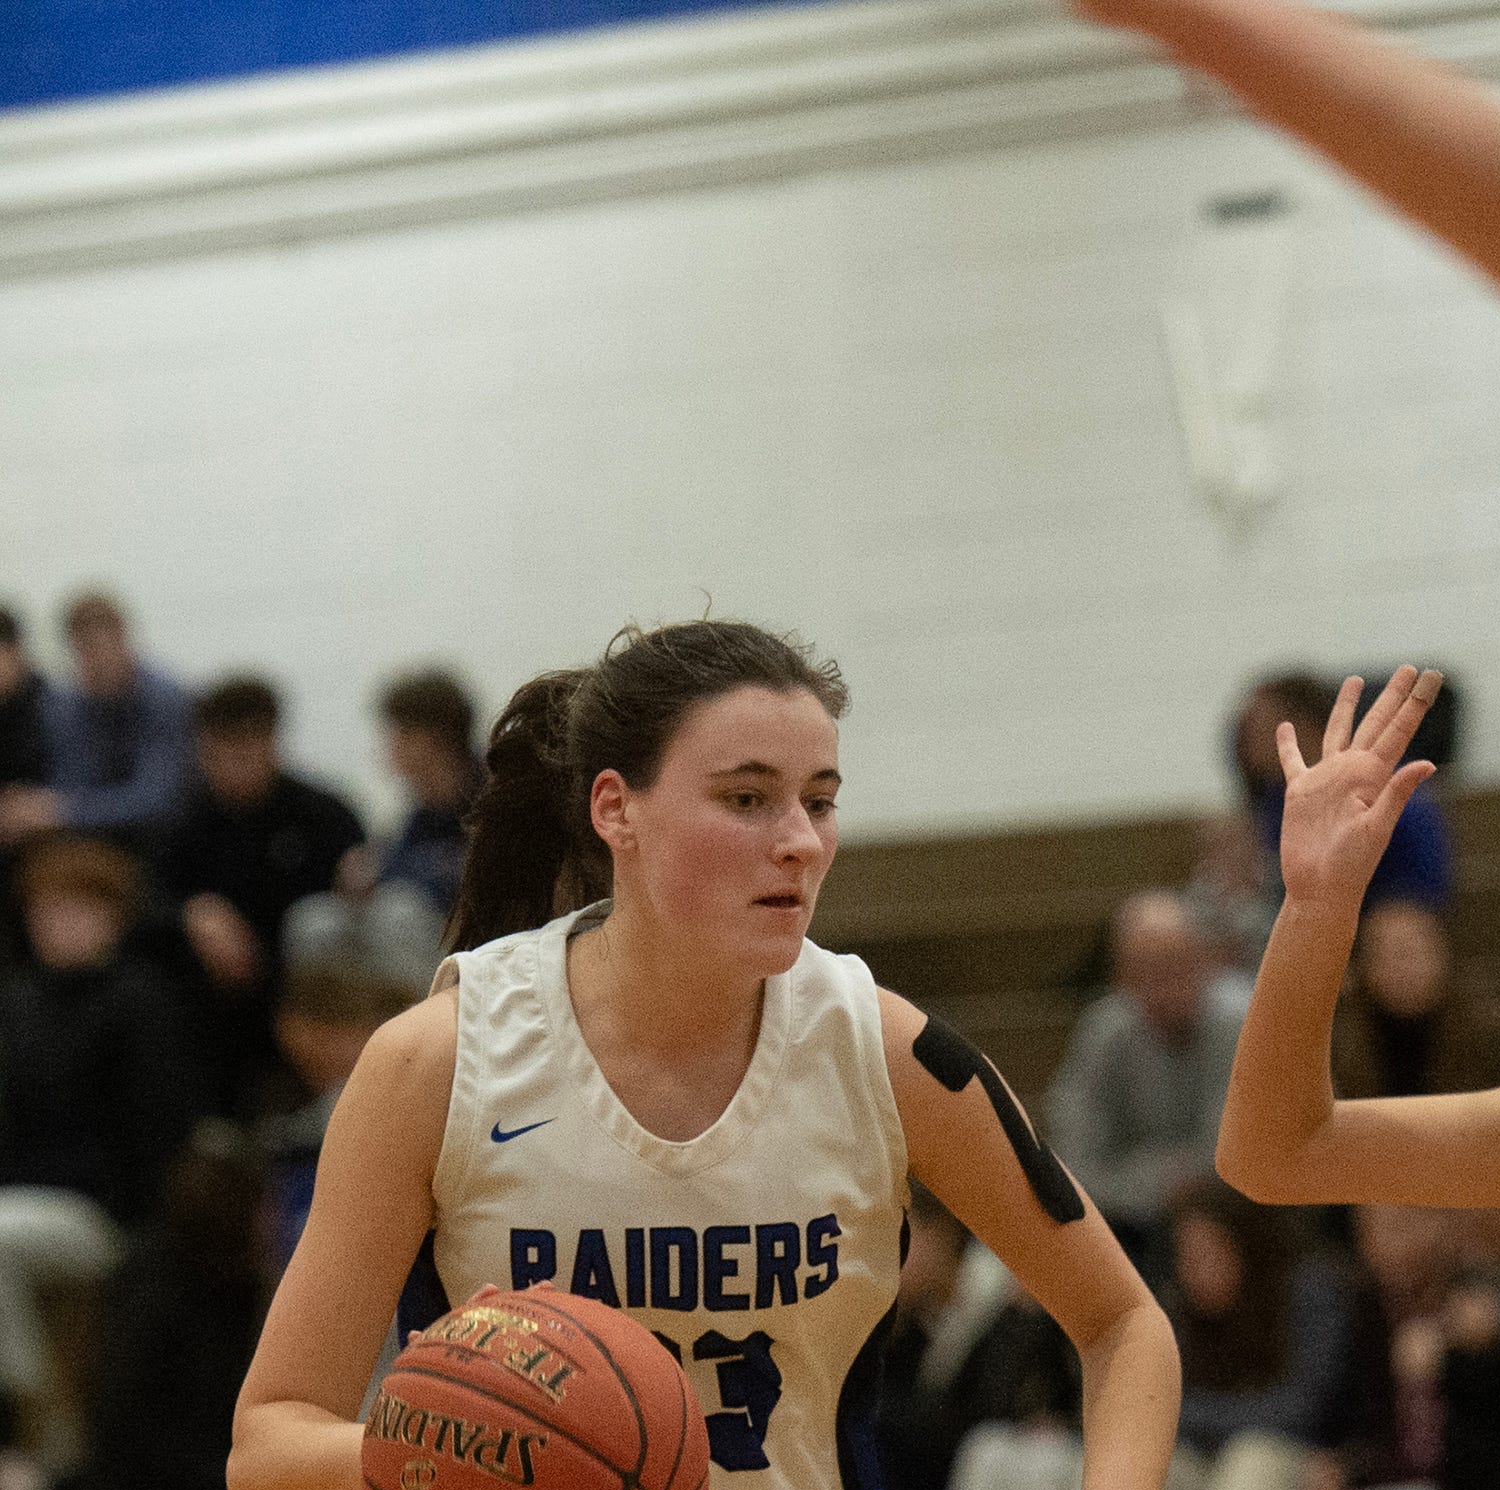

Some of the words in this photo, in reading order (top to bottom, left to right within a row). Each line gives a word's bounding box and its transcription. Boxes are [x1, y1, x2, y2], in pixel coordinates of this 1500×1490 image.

[509, 1213, 843, 1313] RAIDERS
[366, 1389, 549, 1486] SPALDIN
[650, 1329, 783, 1473] 3
